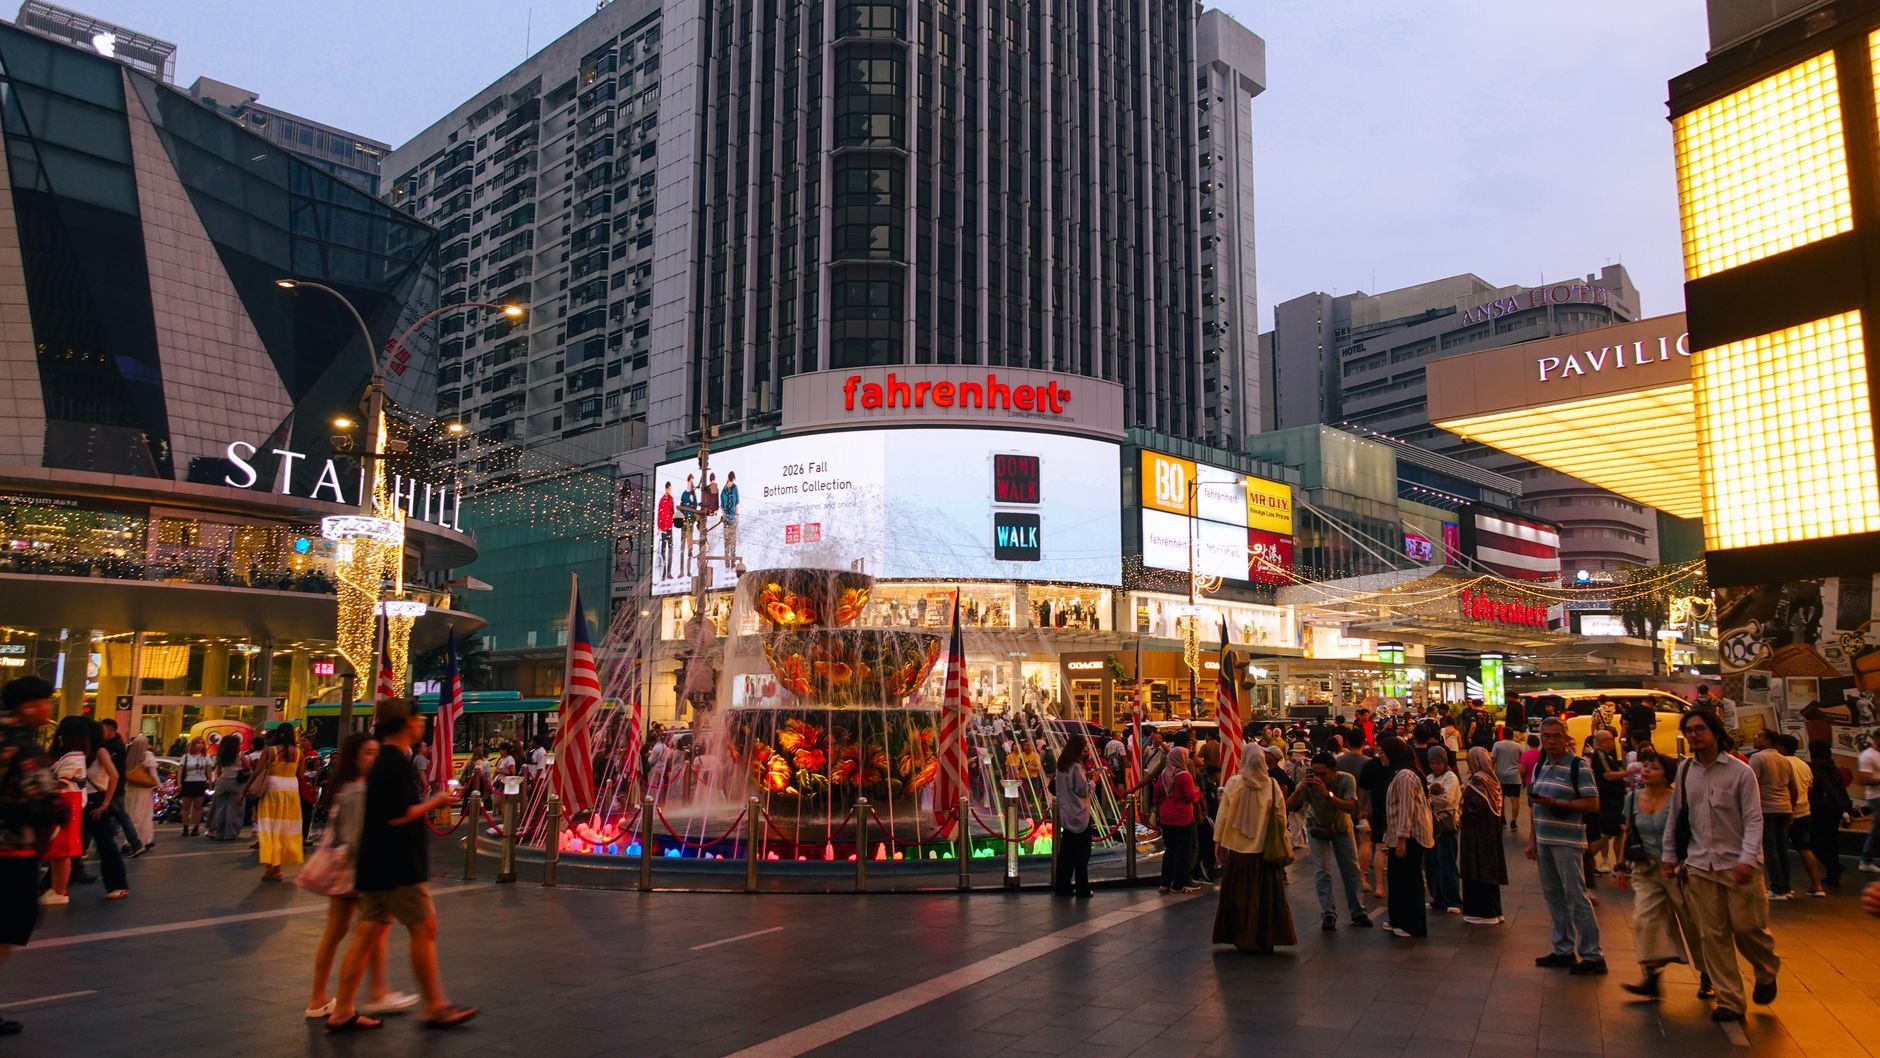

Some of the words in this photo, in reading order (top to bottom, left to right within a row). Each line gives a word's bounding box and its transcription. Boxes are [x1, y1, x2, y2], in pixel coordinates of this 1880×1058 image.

[1461, 295, 1520, 327] ANSA
[1527, 284, 1612, 307] HOTEL
[1341, 343, 1367, 357] HOTEL
[843, 372, 1064, 414] fahrenheit
[782, 464, 805, 477] 2026
[808, 461, 828, 473] Fall
[763, 484, 798, 497] Bottoms
[802, 479, 852, 493] Collection
[997, 480, 1037, 501] WALK
[1155, 458, 1185, 503] BO
[997, 525, 1038, 548] WALK
[1462, 587, 1547, 628] fahrenheit
[1068, 661, 1104, 670] COACH
[1204, 661, 1220, 670] COA
